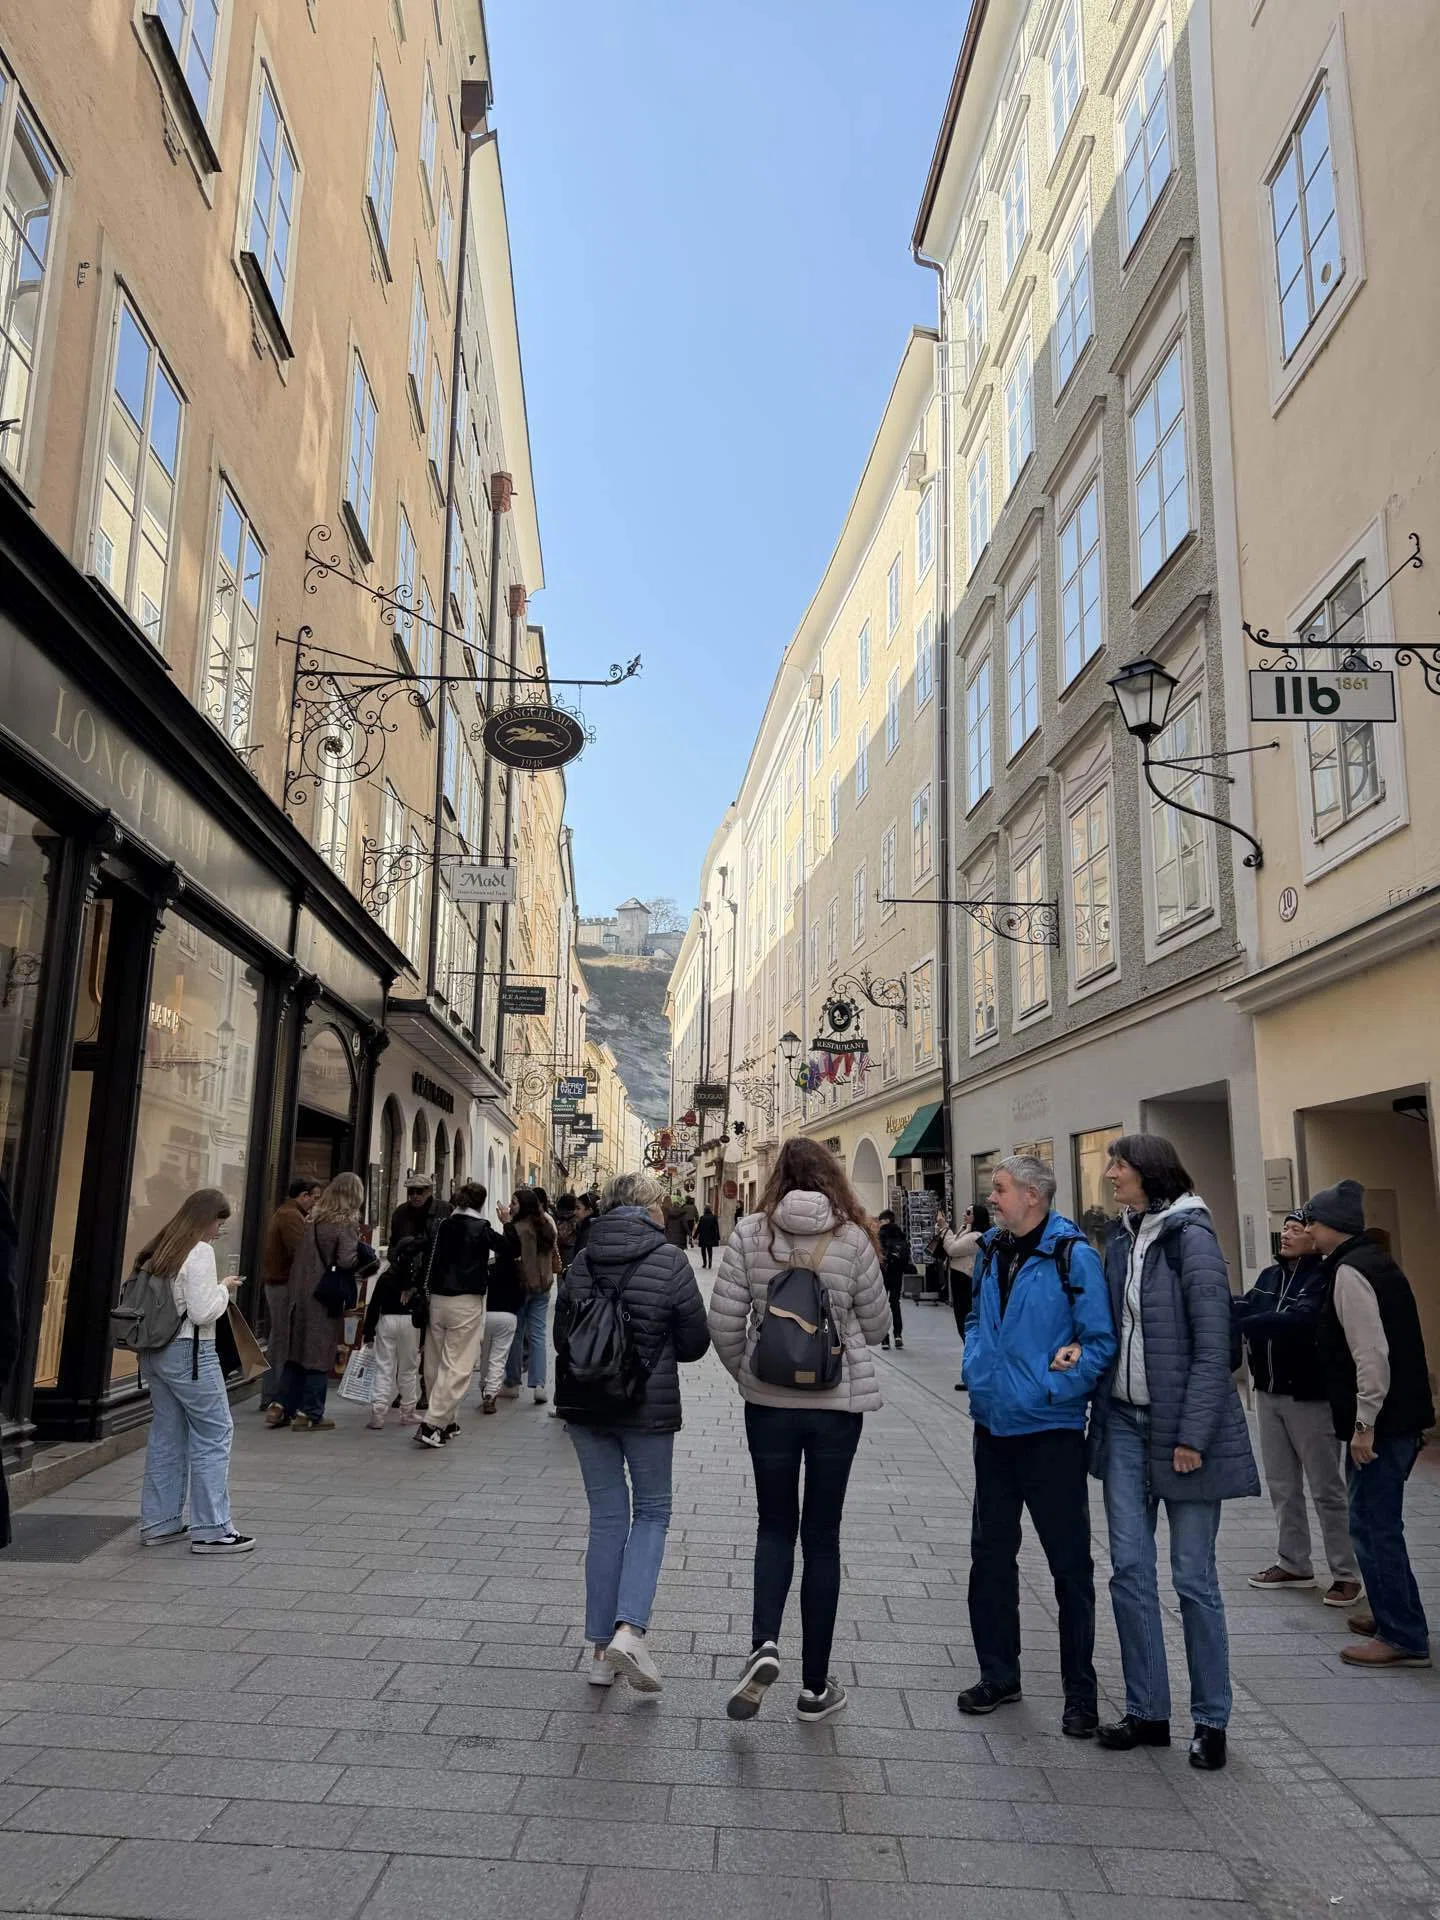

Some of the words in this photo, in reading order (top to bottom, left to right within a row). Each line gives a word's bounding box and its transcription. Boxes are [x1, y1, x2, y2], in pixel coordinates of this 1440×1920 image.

[1336, 677, 1368, 690] 1861
[496, 708, 573, 727] LONGCHAMP
[521, 759, 543, 768] 1948
[459, 873, 506, 888] Madl
[1283, 890, 1293, 908] 10
[816, 1041, 865, 1050] RESTAURANT
